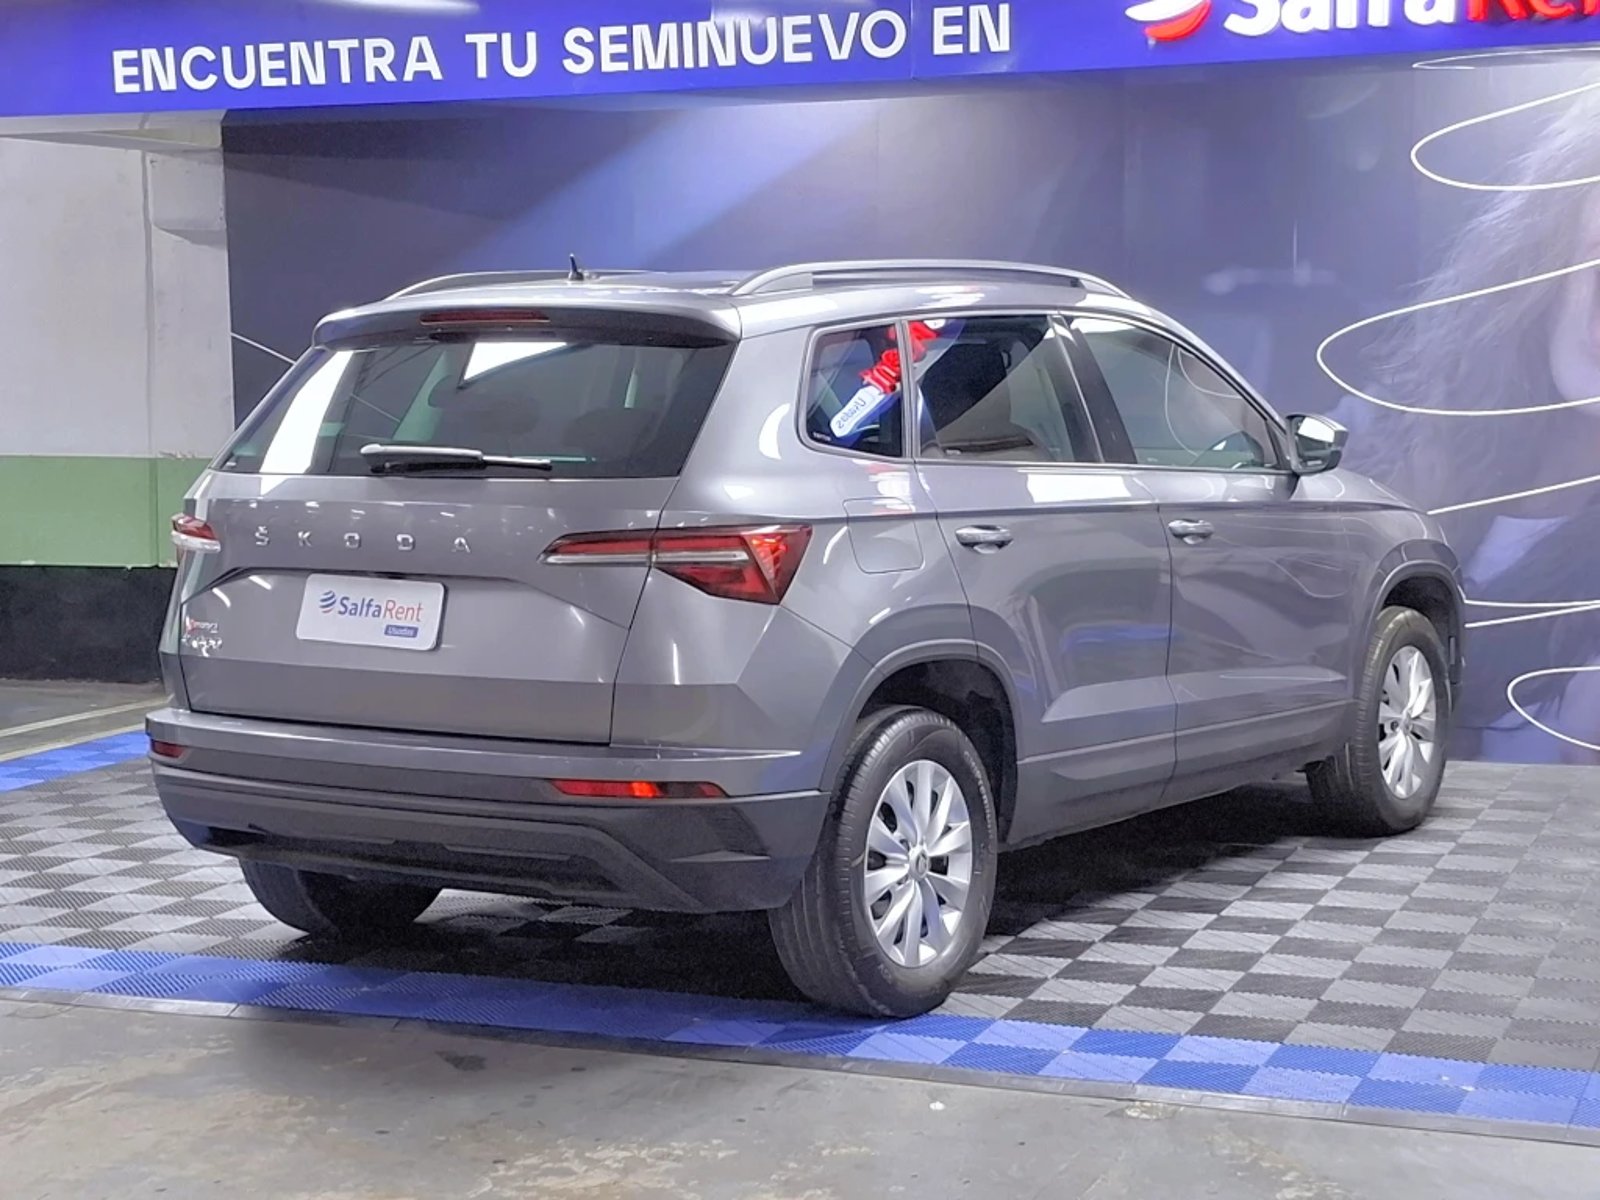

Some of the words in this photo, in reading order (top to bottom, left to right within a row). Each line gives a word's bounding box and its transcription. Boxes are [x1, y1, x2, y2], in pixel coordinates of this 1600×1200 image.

[112, 35, 443, 94] ENCUENTRA
[465, 31, 537, 79] TU
[562, 10, 907, 74] SEMINUEVO
[932, 4, 1010, 55] EN
[338, 596, 423, 622] SalfaRent
